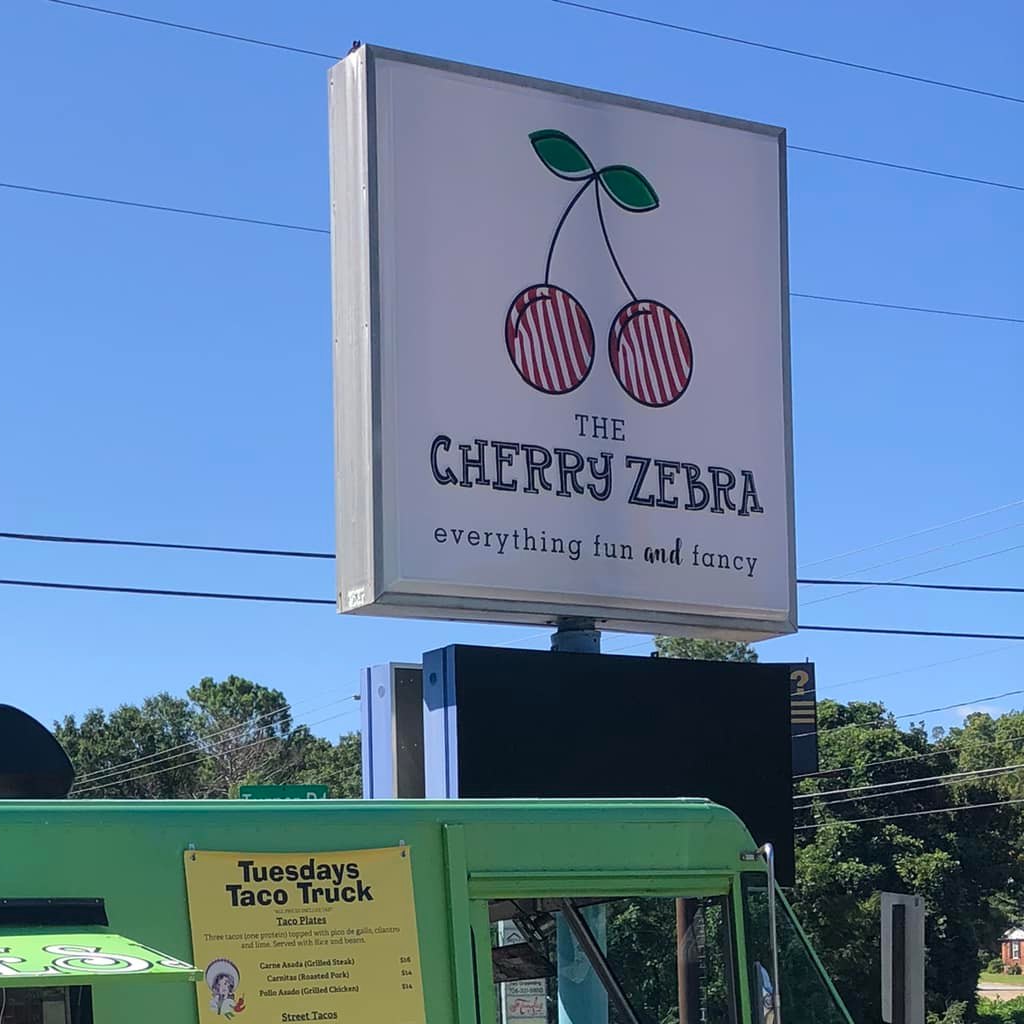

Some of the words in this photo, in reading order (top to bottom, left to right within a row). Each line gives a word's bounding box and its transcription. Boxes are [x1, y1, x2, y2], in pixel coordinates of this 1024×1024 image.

[575, 414, 625, 441] THE
[430, 435, 614, 501] CHERRY
[626, 456, 763, 516] ZEBRA
[434, 525, 582, 560] everything
[594, 535, 633, 560] fun
[644, 538, 683, 566] and
[692, 544, 758, 577] fancy
[238, 859, 359, 885] Tuesdays
[226, 884, 288, 906] Taco
[297, 880, 374, 904] Truck
[277, 917, 298, 926] Taco
[300, 916, 326, 925] Plates
[282, 961, 303, 969] Asada
[267, 974, 296, 982] Carnitas
[260, 989, 277, 997] Pollo
[278, 988, 299, 996] Asado
[282, 1012, 309, 1022] Street
[312, 1011, 337, 1020] Tacos
